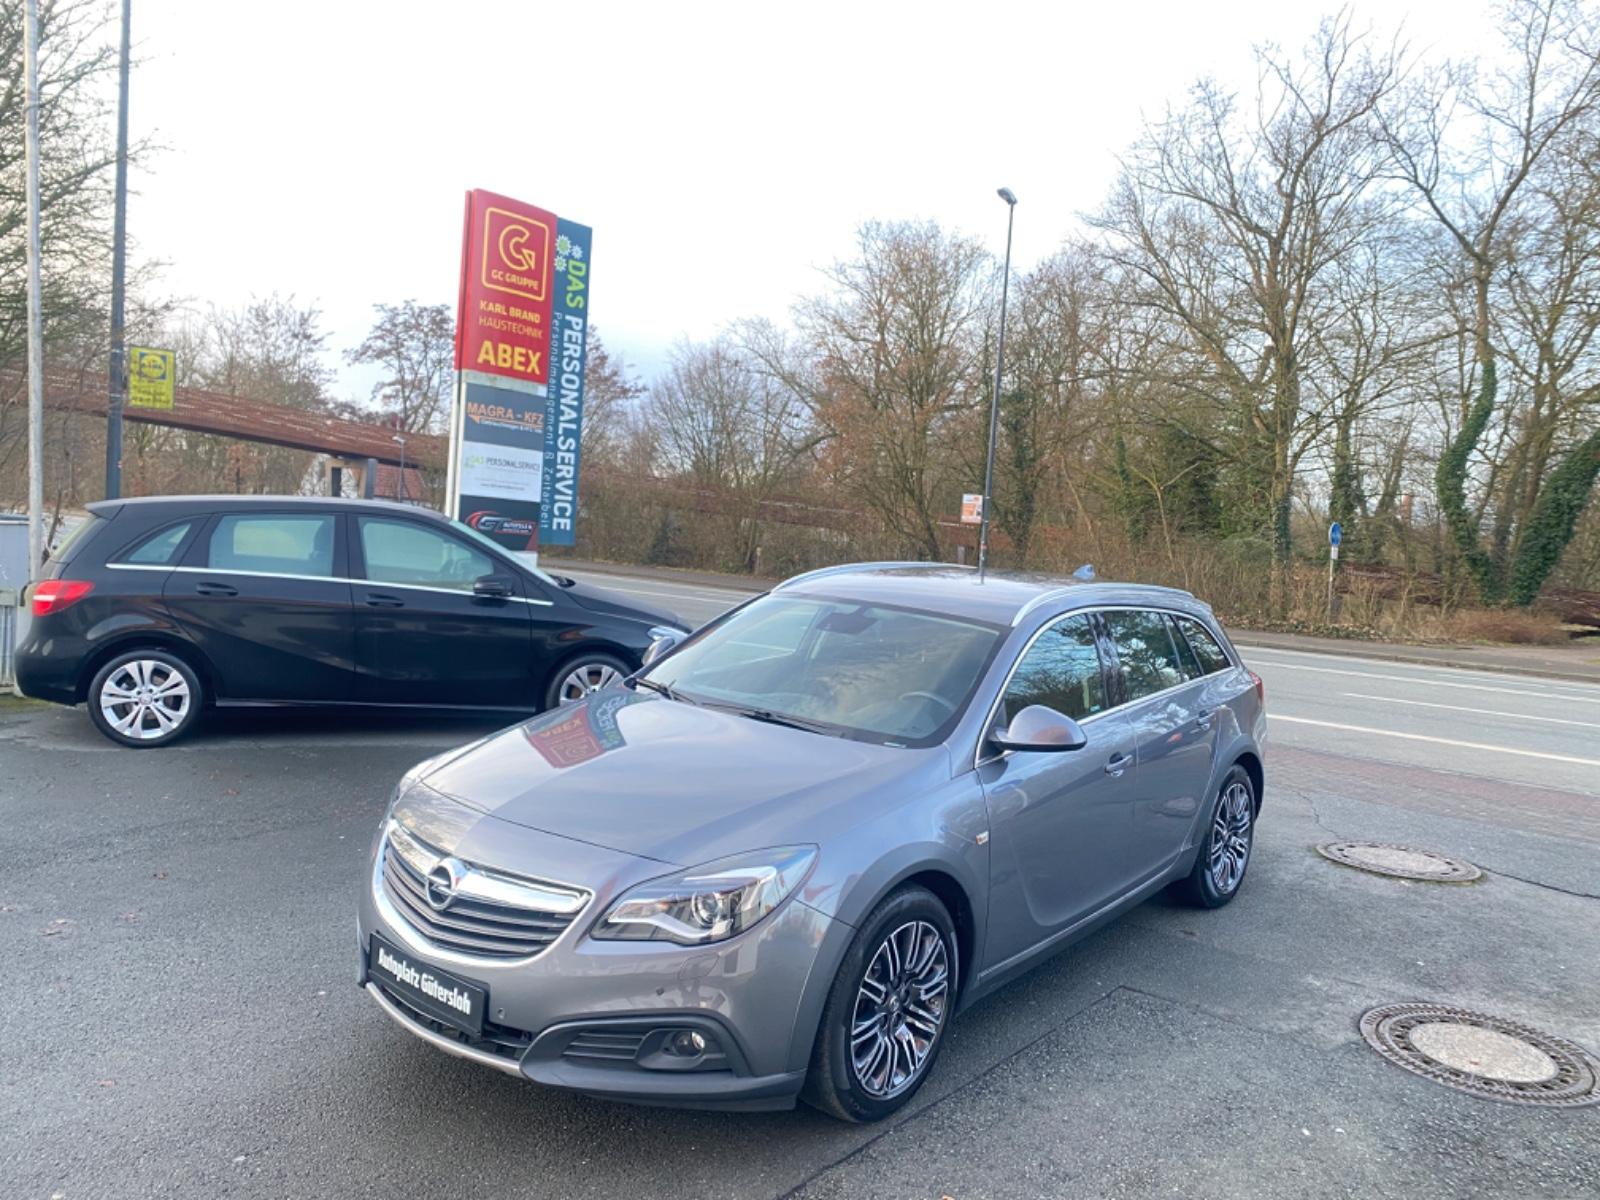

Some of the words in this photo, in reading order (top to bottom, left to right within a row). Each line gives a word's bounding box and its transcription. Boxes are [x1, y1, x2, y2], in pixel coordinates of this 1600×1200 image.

[491, 269, 504, 281] GC
[505, 272, 539, 290] GRUPPE
[566, 259, 587, 309] DAS
[479, 316, 543, 339] HAUSTECHNIK
[480, 300, 507, 315] KARL
[509, 306, 541, 323] BRAND
[477, 340, 541, 375] ABEX
[545, 312, 562, 445] Personalmanagement
[467, 402, 514, 420] MAGRA
[524, 410, 545, 425] KFZ
[552, 315, 583, 531] PERSONALSERVICE
[541, 467, 554, 528] Zeitarbeit
[378, 947, 420, 988] Autoplatz
[420, 973, 472, 1015] Gütersloh
